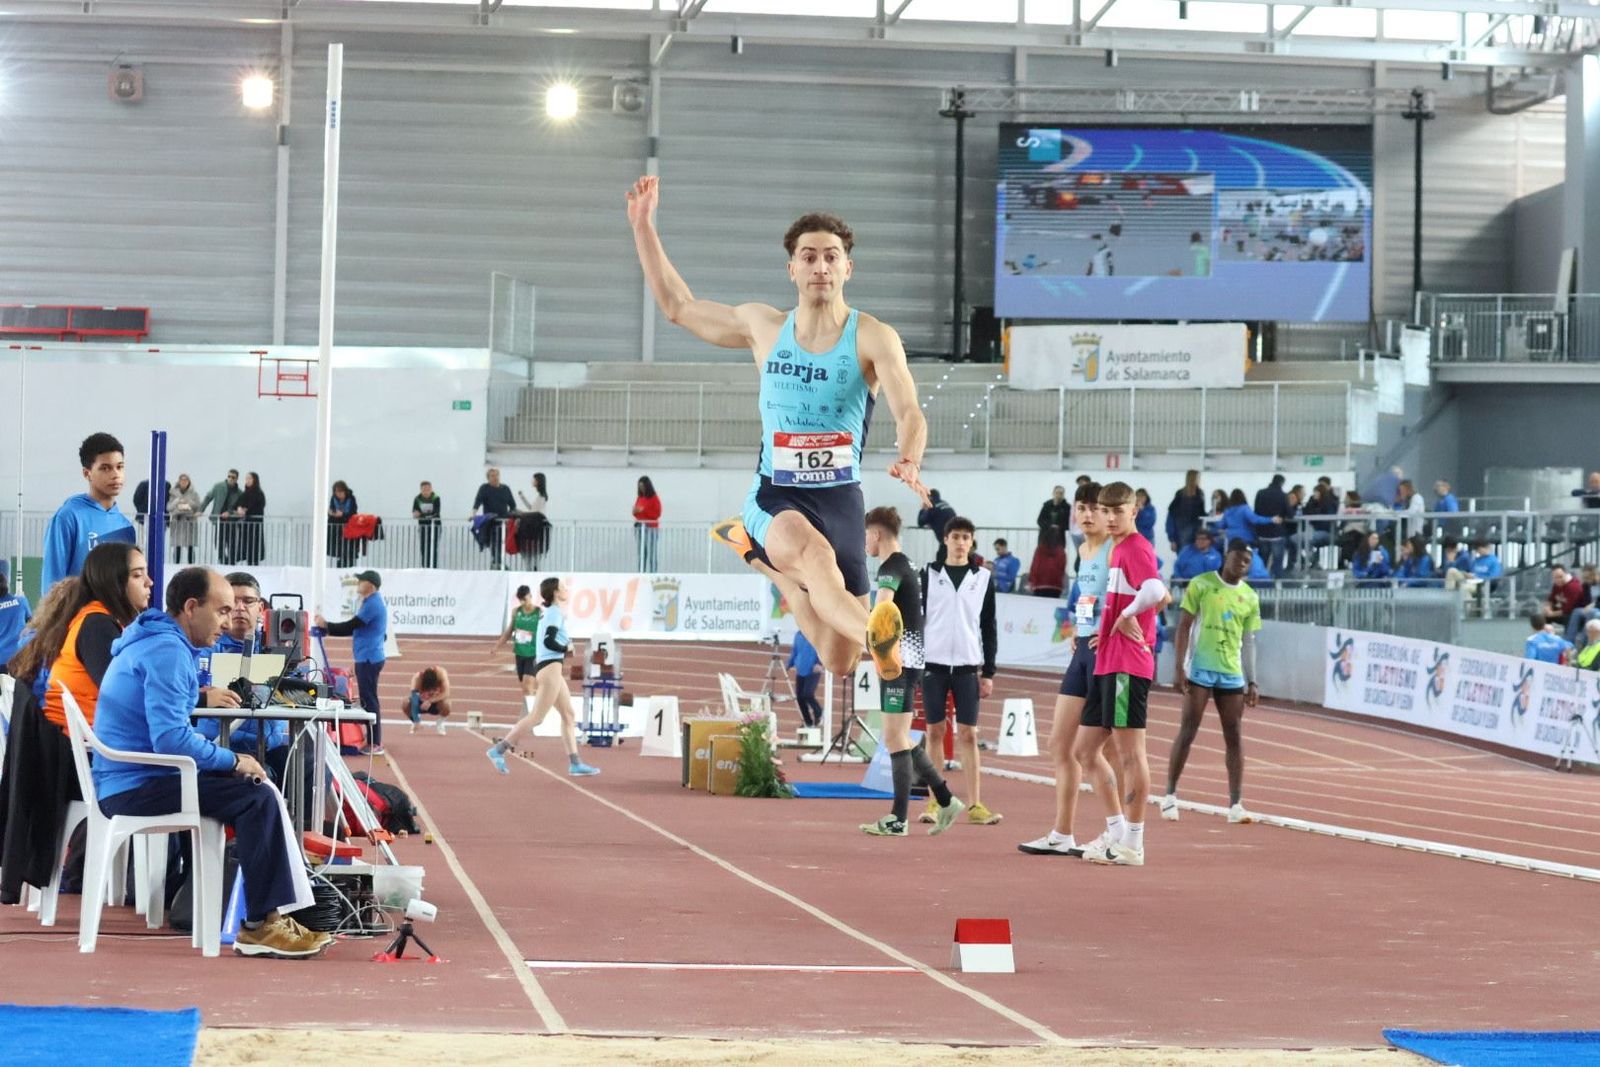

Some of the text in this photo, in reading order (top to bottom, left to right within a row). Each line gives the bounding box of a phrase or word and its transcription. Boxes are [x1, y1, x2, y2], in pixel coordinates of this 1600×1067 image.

[1105, 350, 1191, 365] Ayuntamiento
[766, 361, 829, 384] nerja
[1105, 366, 1190, 381] de Salamanca
[794, 450, 834, 469] 162
[384, 594, 456, 608] yuntamiento
[684, 595, 760, 613] Ayuntamiento
[392, 610, 455, 625] Salamanca
[684, 615, 760, 631] de Salamanca
[598, 642, 608, 660] 5
[858, 671, 870, 693] 4
[1366, 663, 1417, 690] ATLETISMO
[655, 709, 663, 736] 1
[1006, 712, 1016, 736] 2
[1024, 711, 1032, 736] 2
